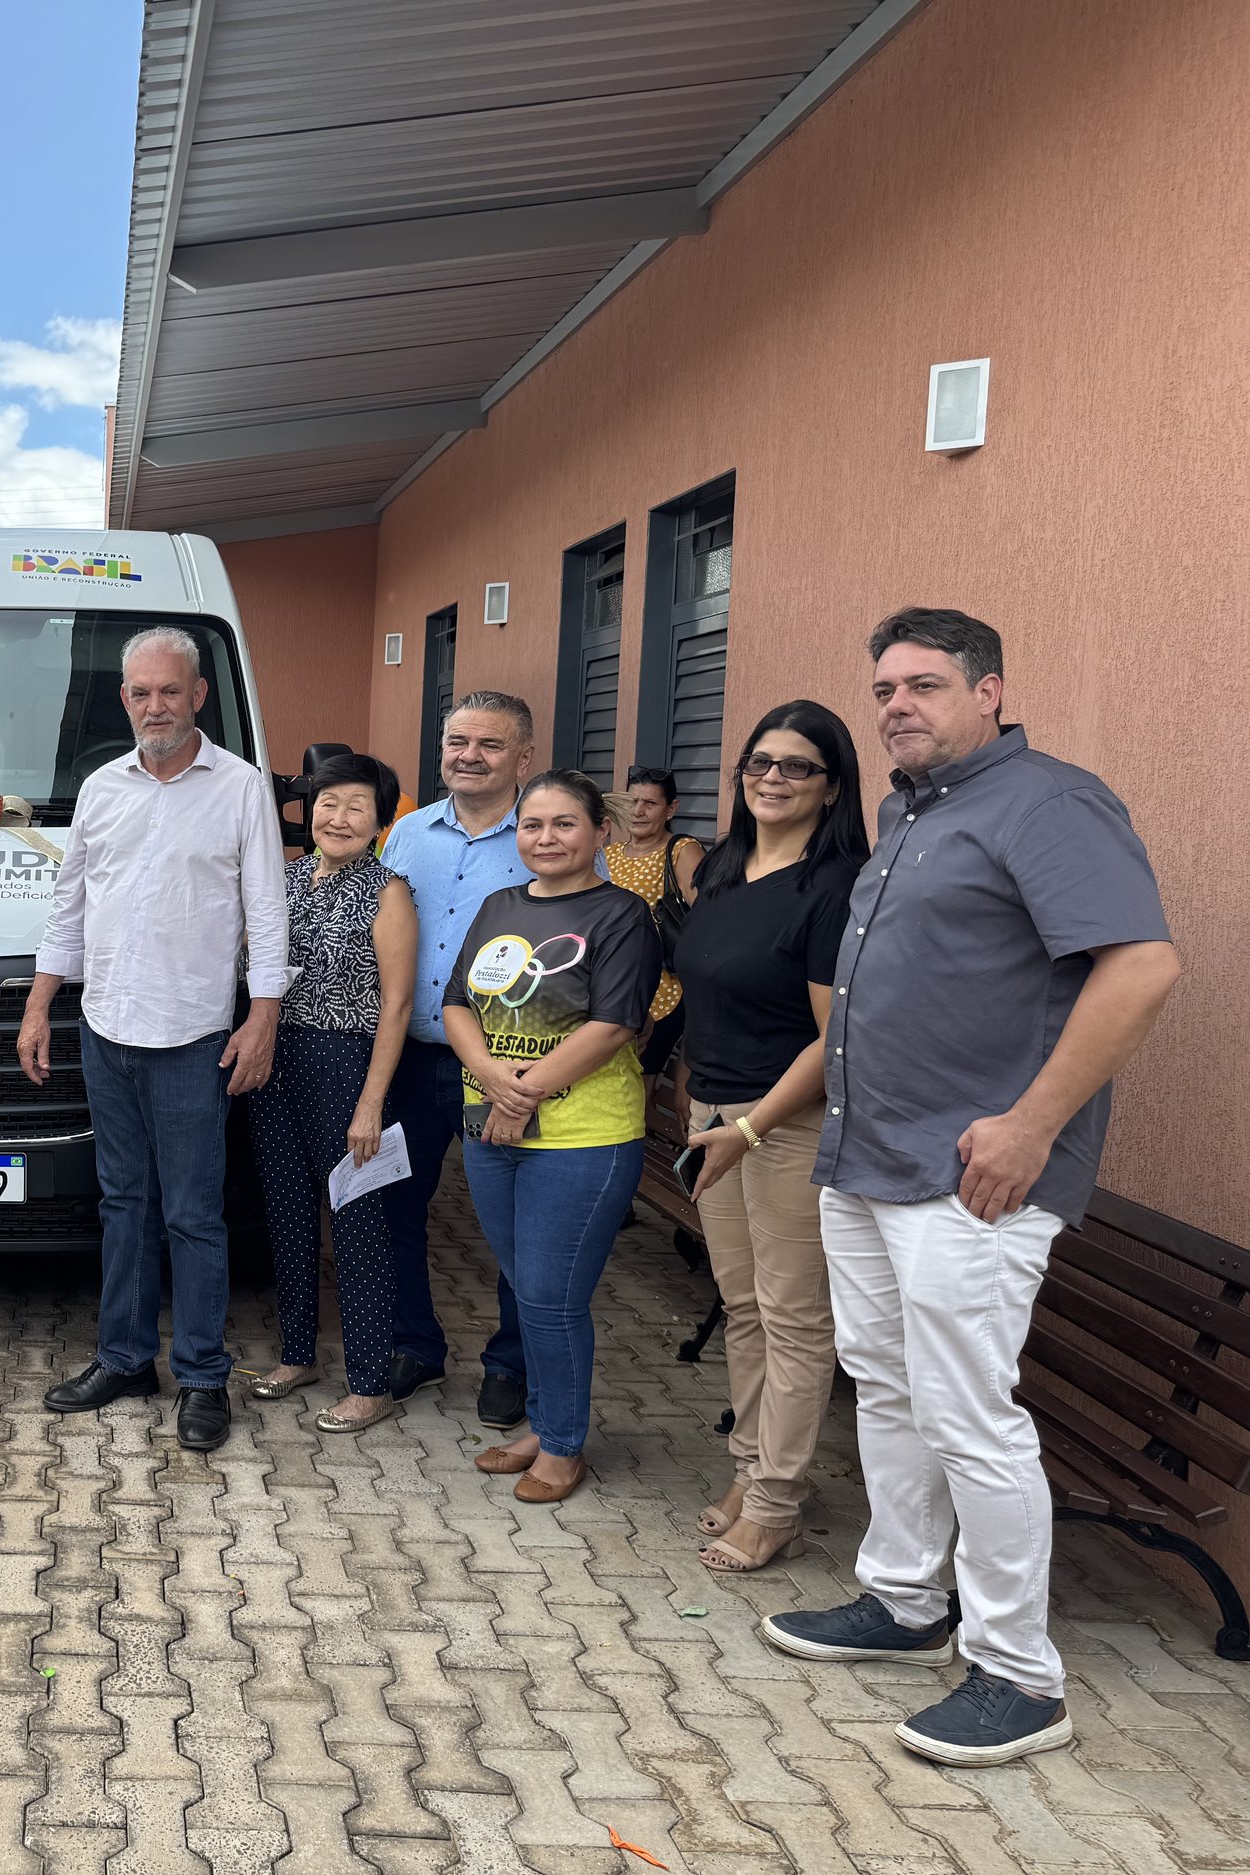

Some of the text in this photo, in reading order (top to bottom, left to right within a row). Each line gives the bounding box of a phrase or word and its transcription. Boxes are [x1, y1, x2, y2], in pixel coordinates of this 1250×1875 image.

[82, 551, 131, 560] FEDERAL
[12, 554, 142, 582] BRASIL
[61, 577, 132, 589] RECONSTRUÇÃO
